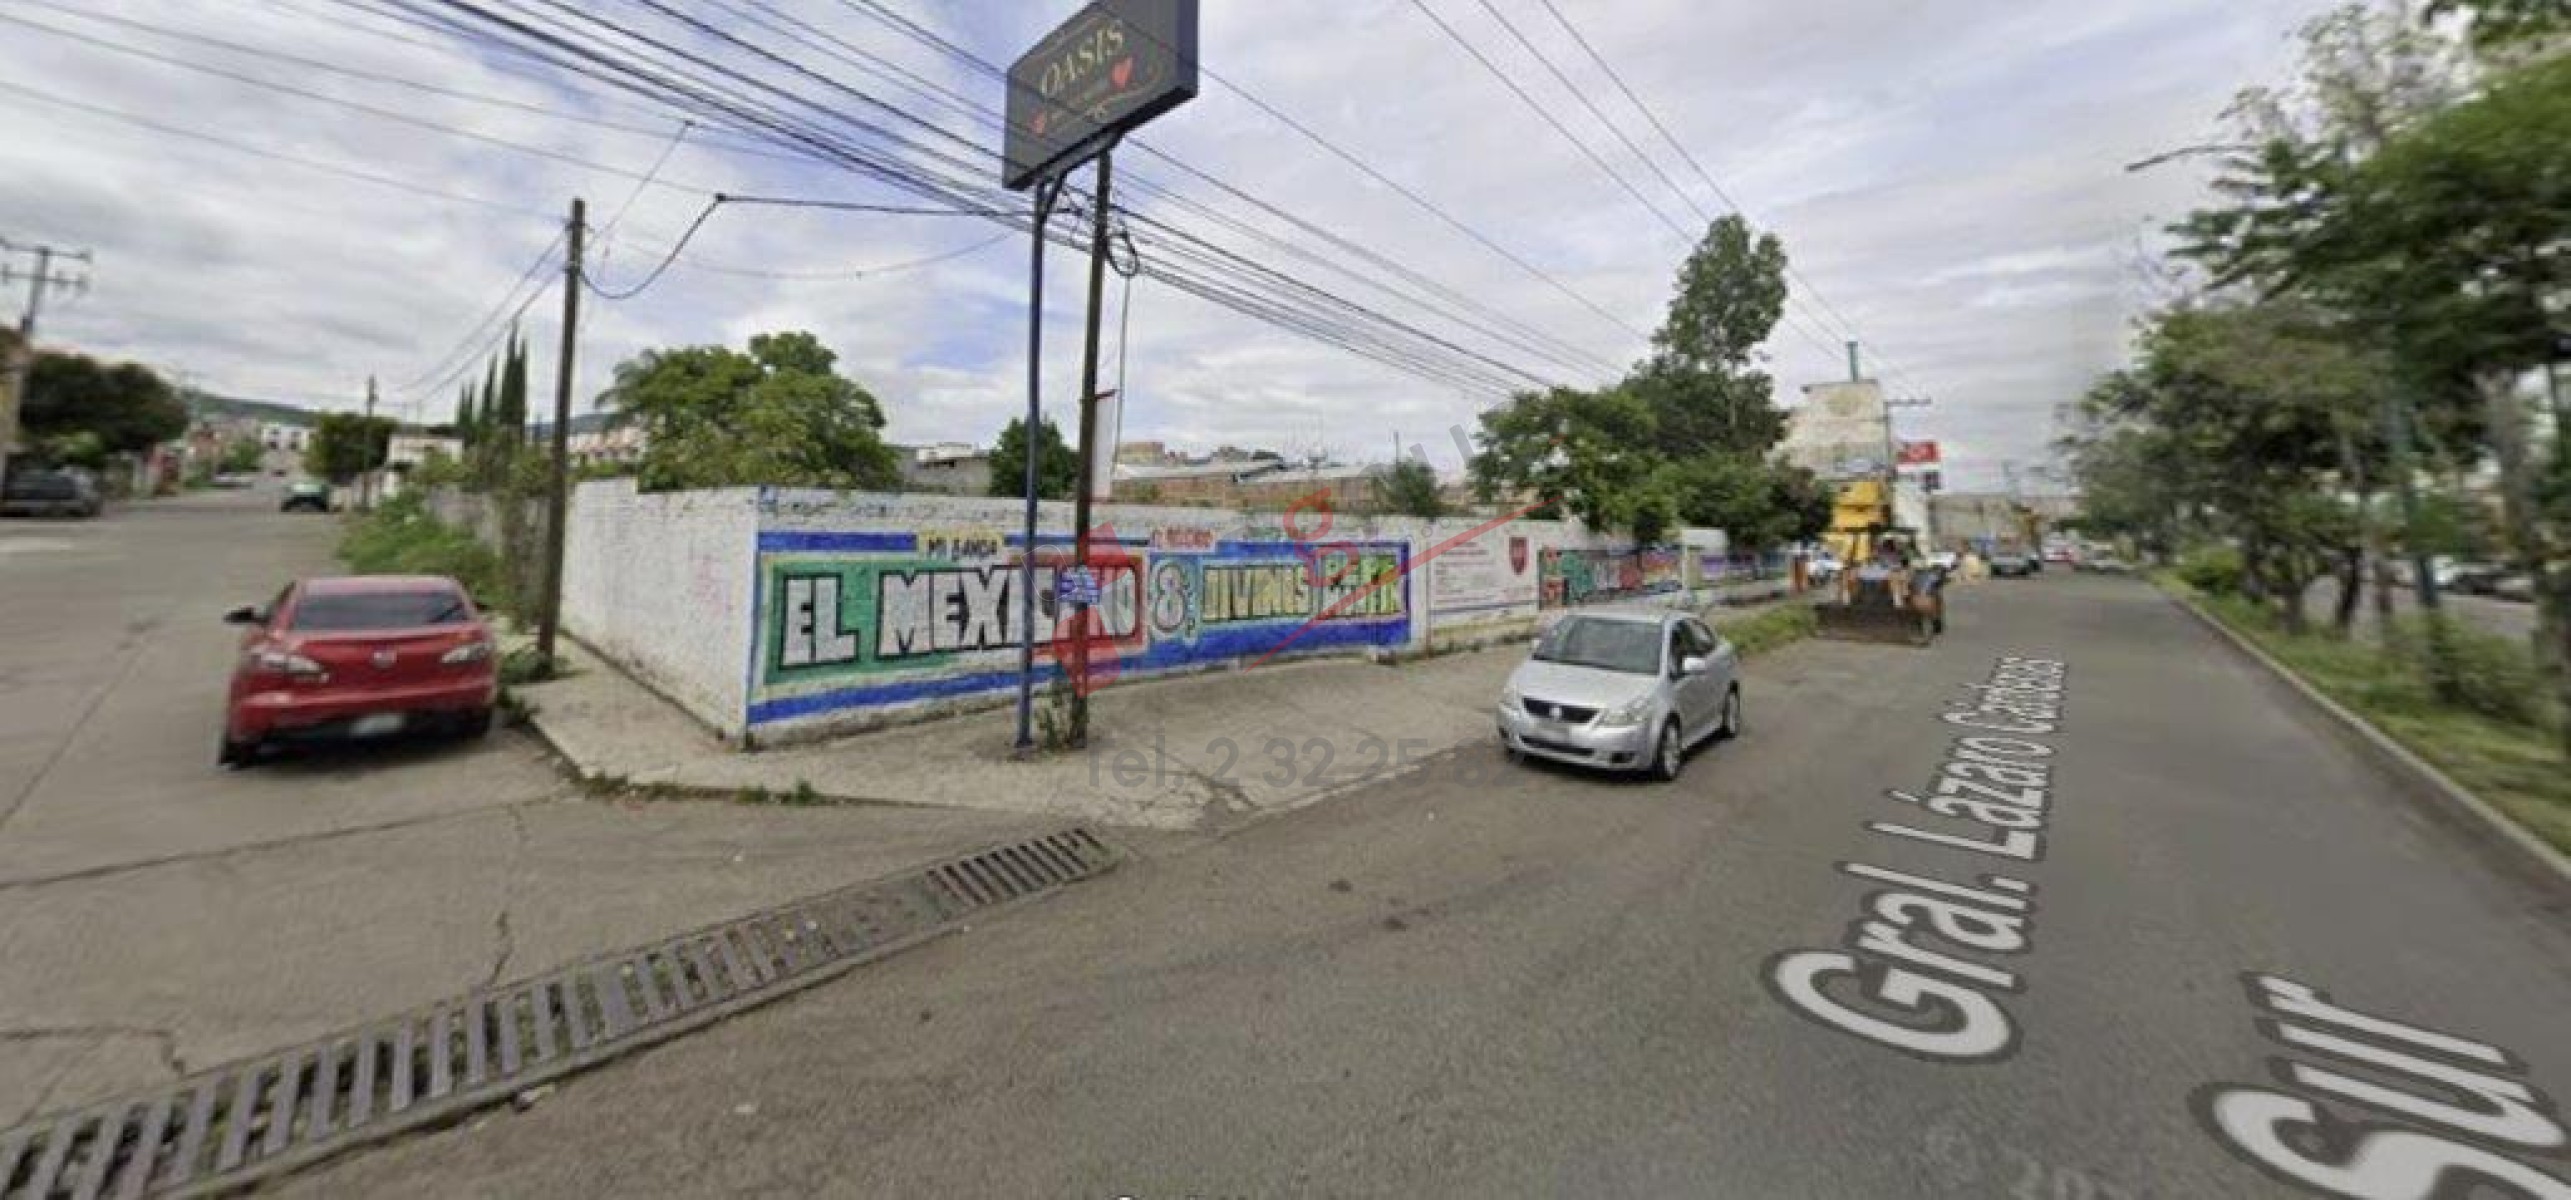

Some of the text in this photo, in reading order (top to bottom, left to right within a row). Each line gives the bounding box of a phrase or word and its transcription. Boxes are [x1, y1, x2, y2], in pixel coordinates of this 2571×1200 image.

[1041, 22, 1123, 96] OASIS
[779, 564, 1139, 671] EL MEXICNO
